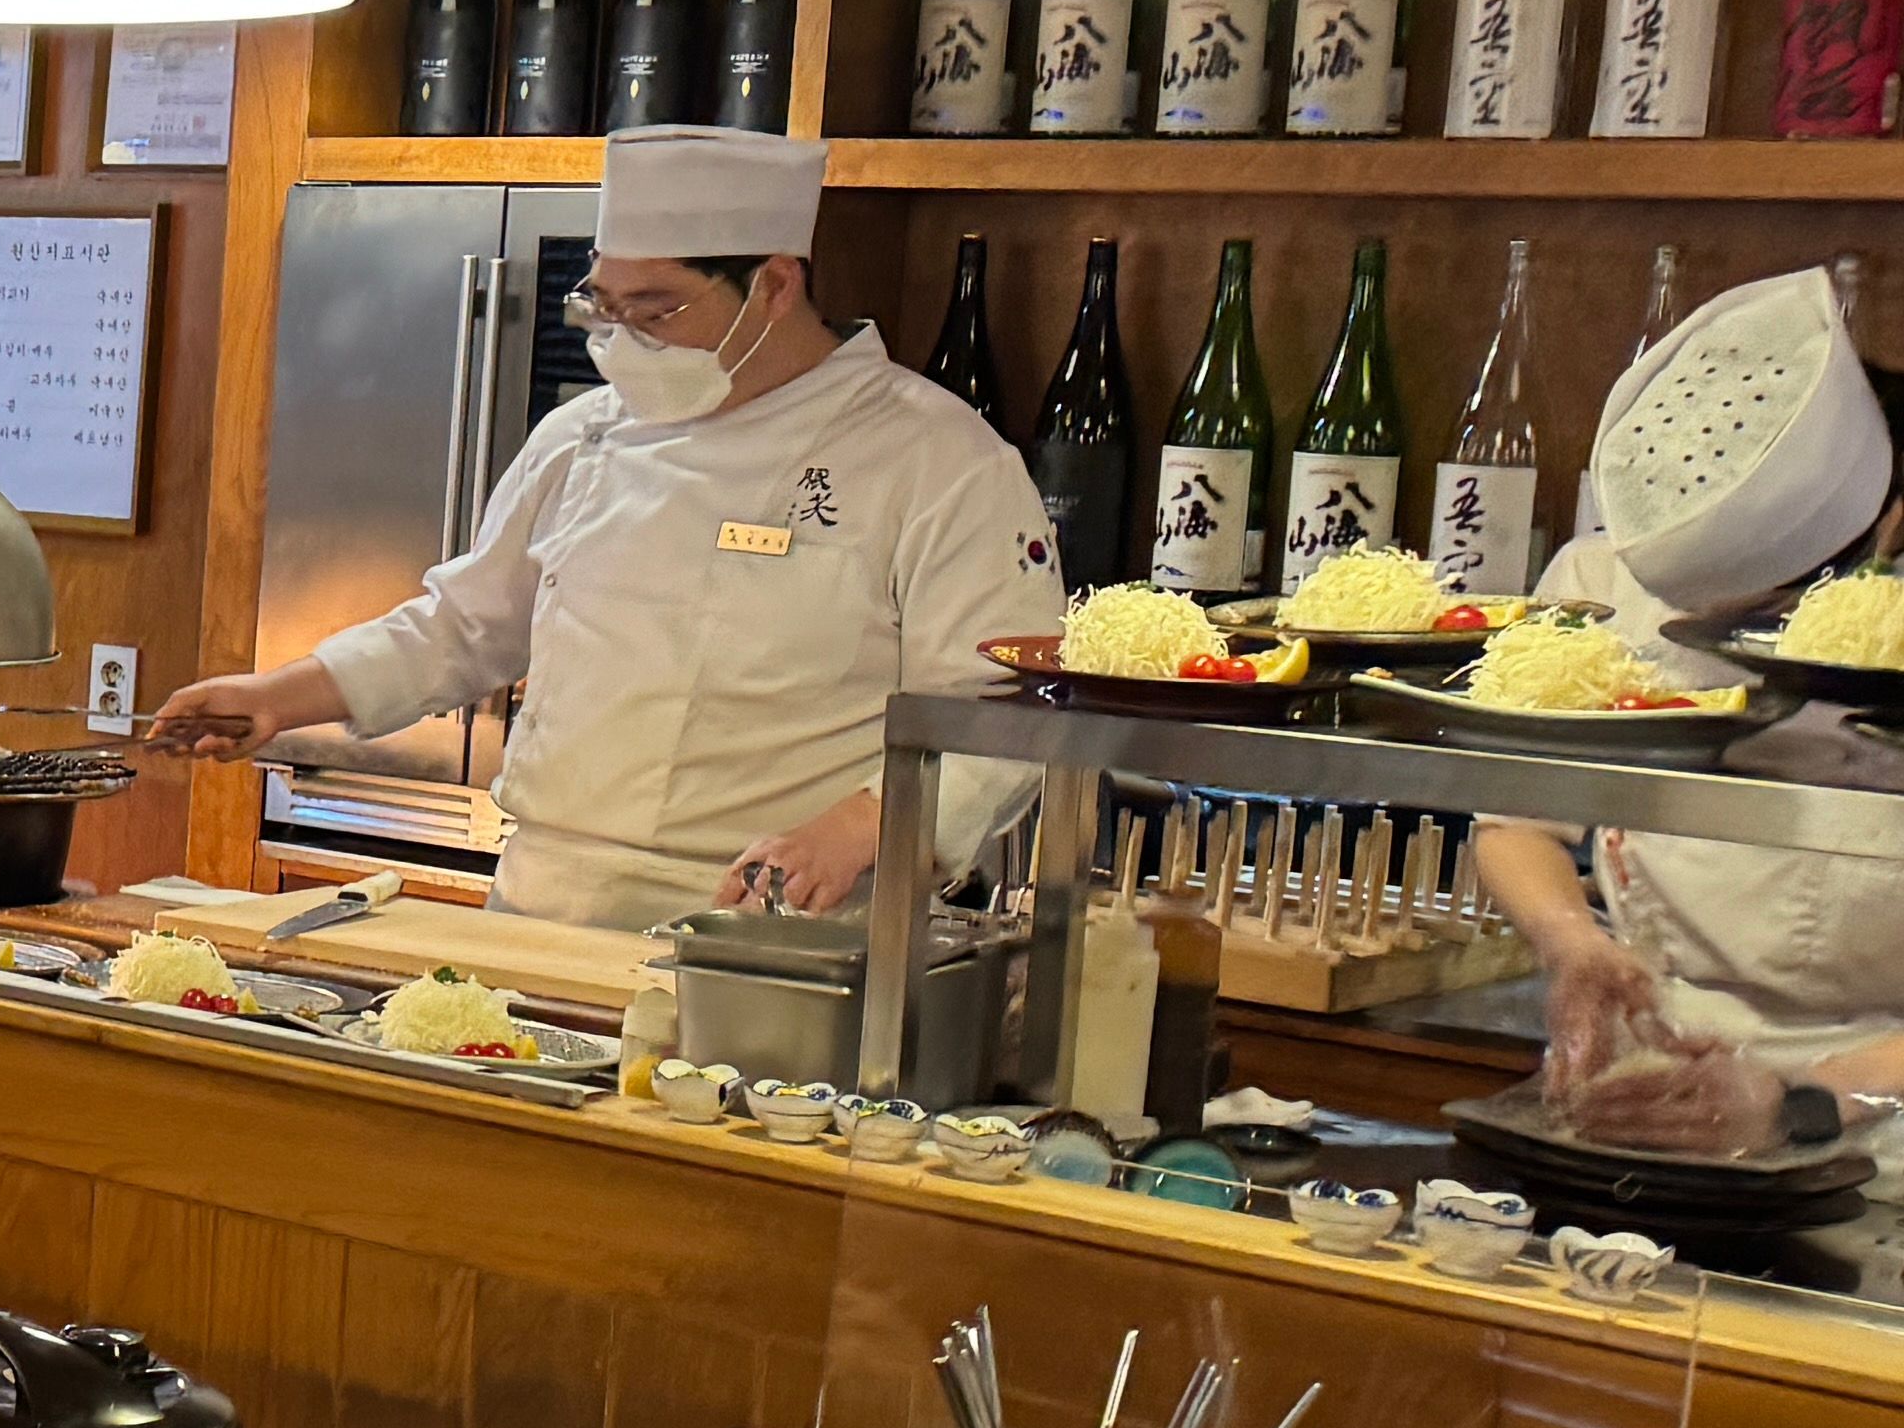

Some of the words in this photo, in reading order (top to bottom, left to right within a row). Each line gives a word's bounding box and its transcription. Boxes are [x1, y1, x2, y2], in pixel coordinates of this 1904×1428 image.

[1163, 13, 1246, 95] 八海山
[1291, 10, 1372, 91] 八海山
[1156, 474, 1225, 547] 八海山
[1288, 481, 1376, 556] 八海山
